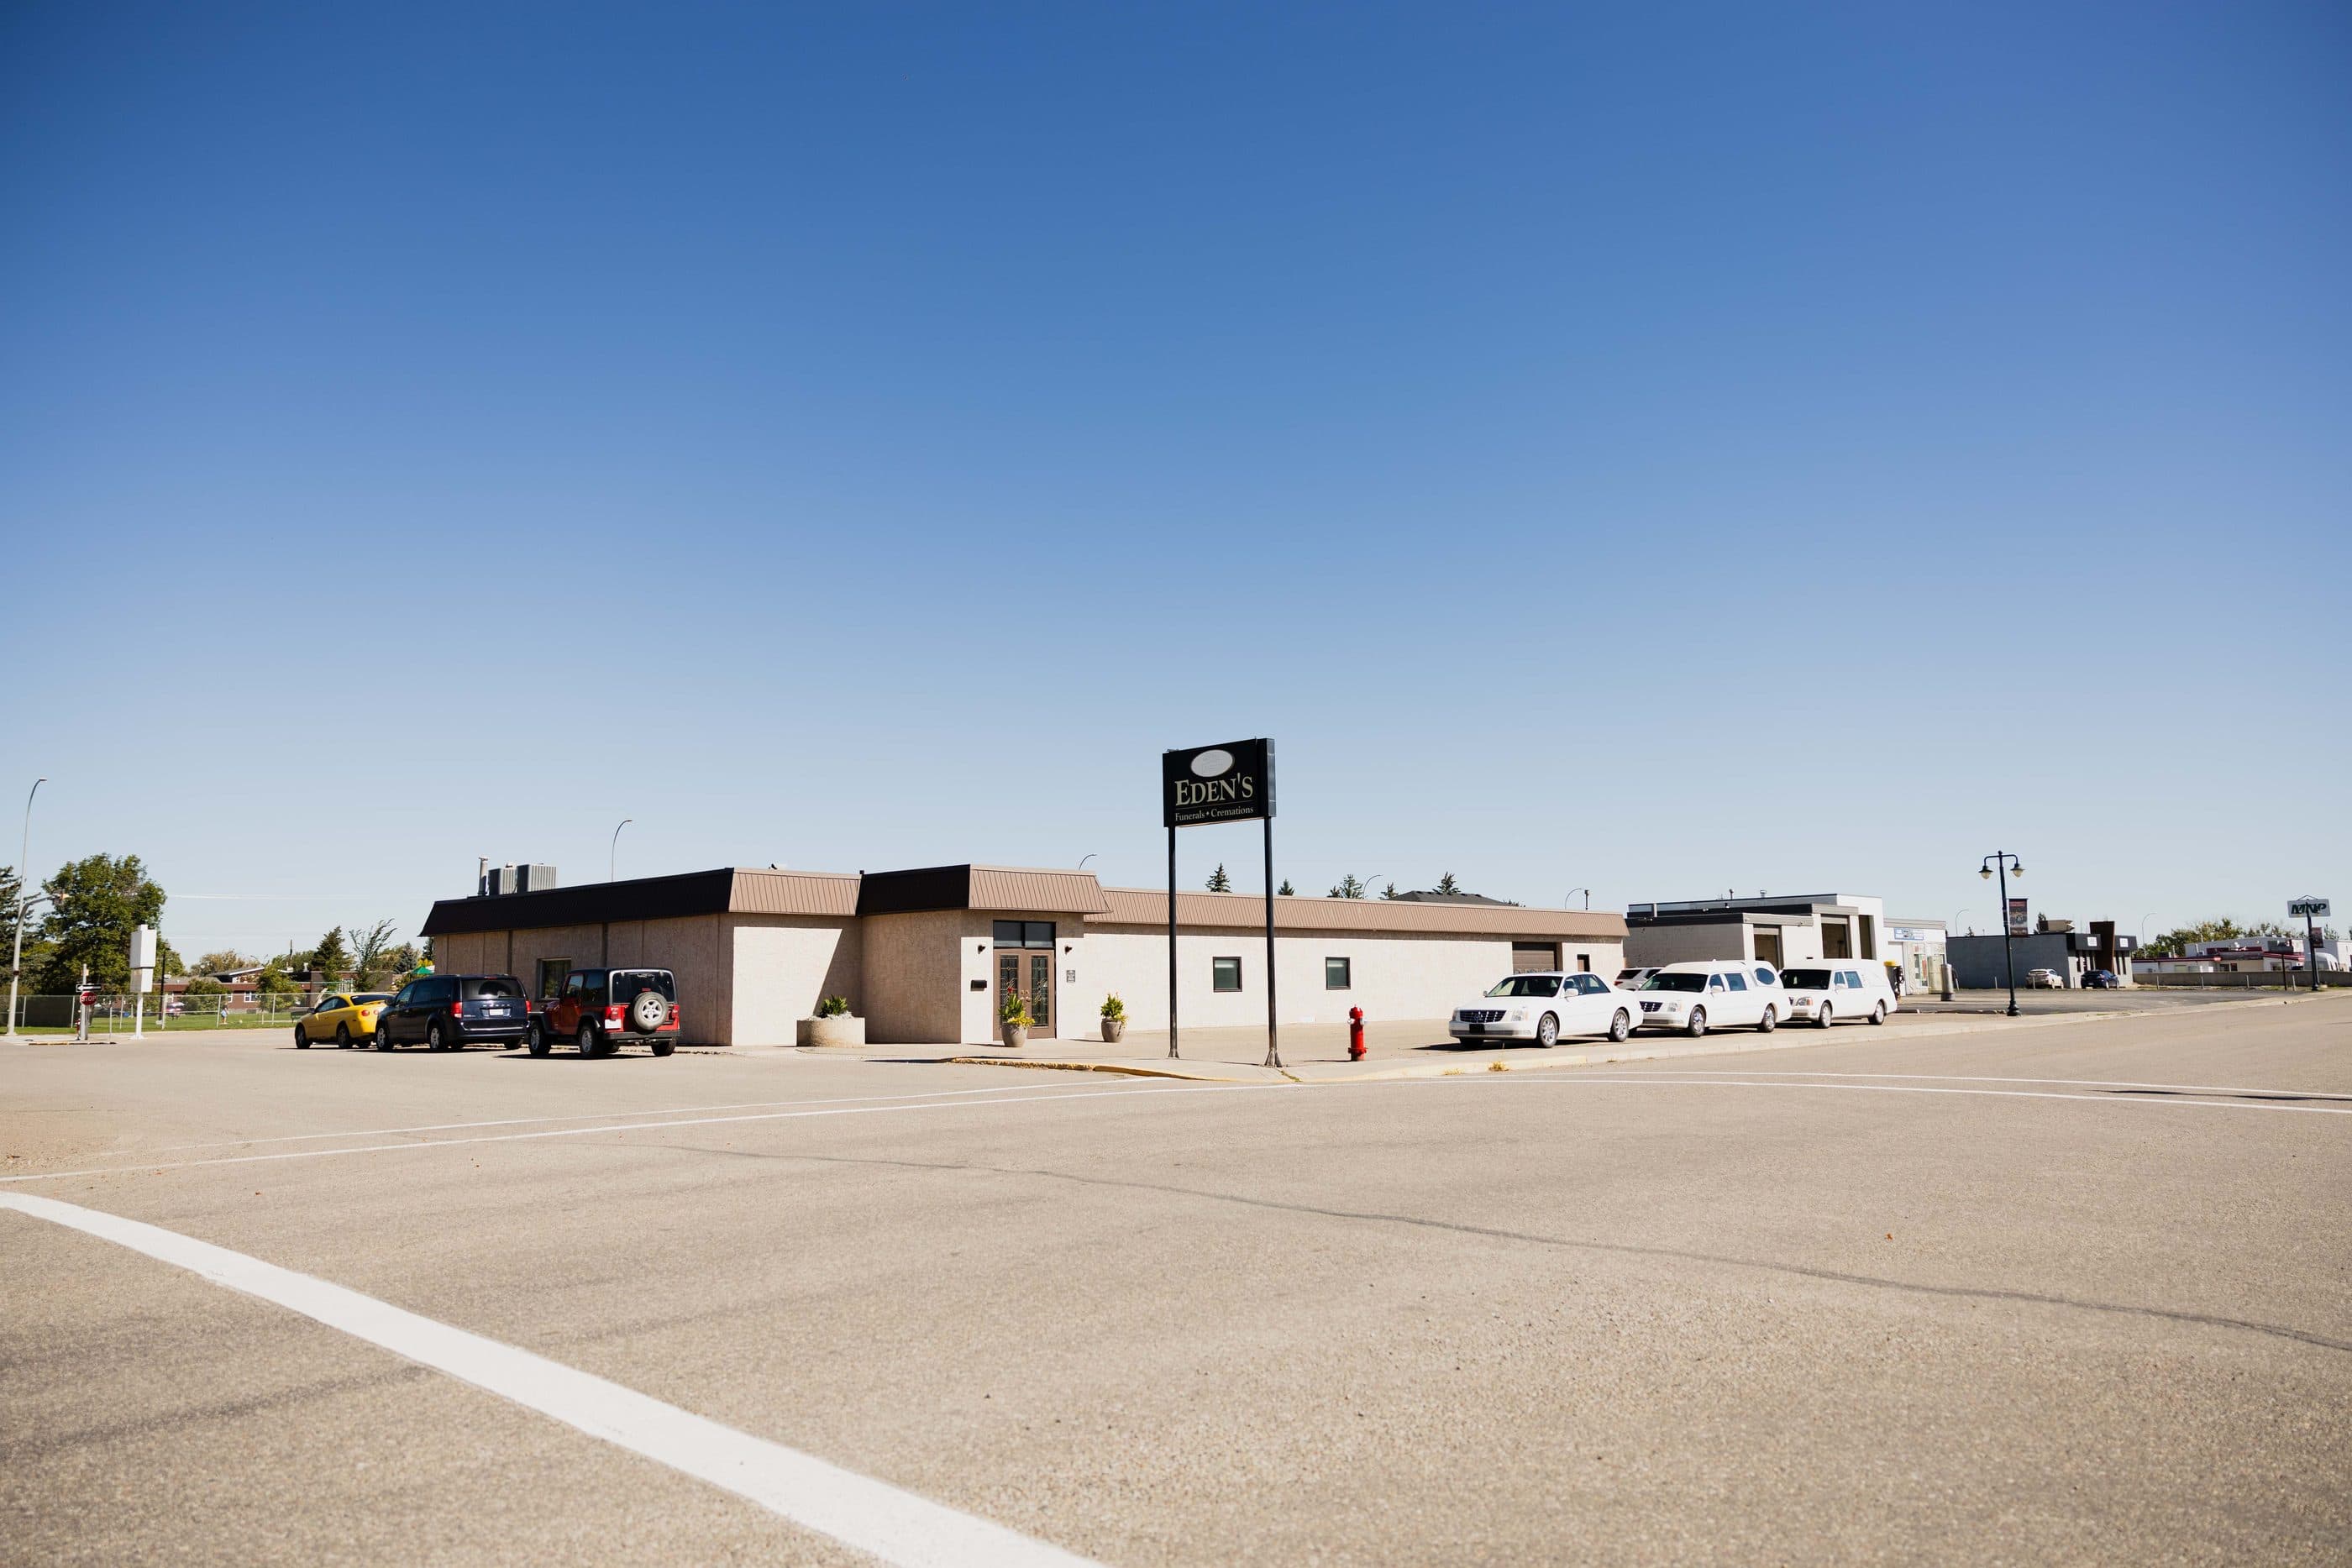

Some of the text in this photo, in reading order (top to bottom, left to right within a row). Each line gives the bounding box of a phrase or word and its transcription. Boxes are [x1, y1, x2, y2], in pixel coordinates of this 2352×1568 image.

[1174, 773, 1253, 806] EDEN'S
[1175, 806, 1254, 821] Funerals Cremations
